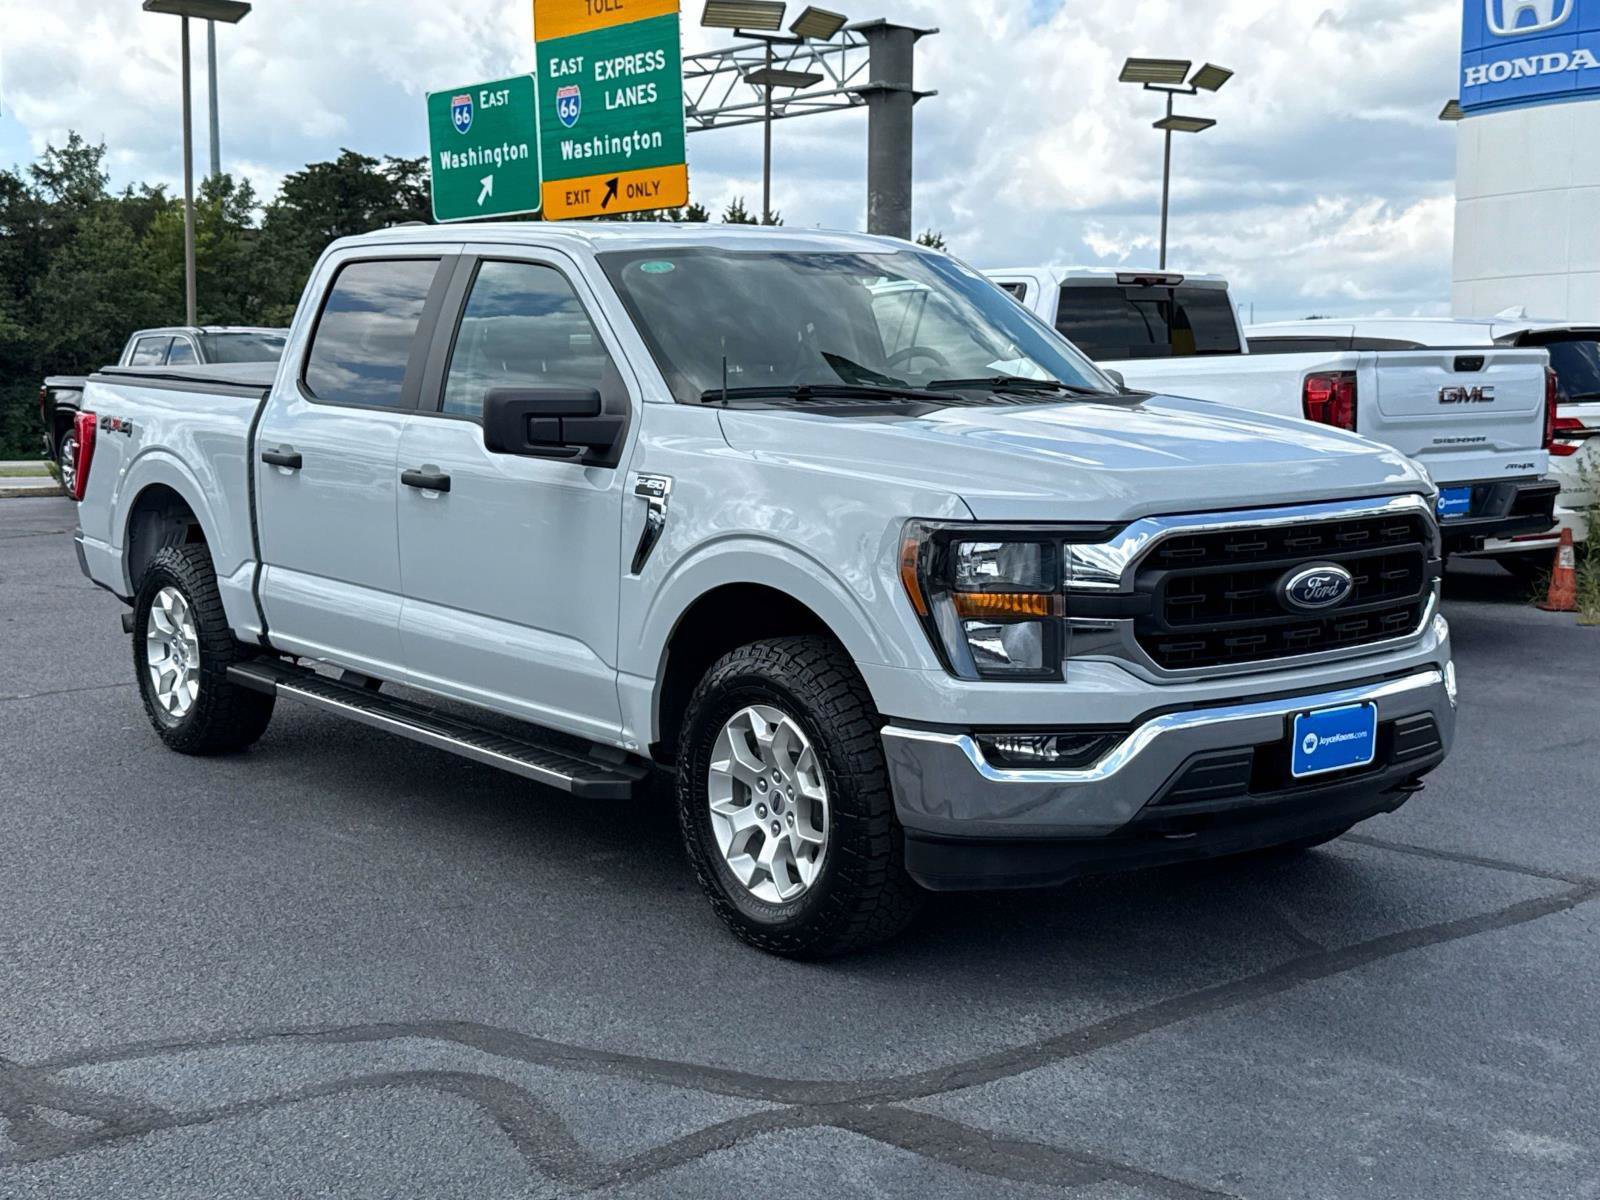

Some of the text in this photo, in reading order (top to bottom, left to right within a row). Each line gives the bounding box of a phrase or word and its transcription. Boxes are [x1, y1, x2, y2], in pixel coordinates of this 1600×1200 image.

[549, 56, 584, 78] EAST
[594, 49, 666, 81] EXPRESS
[1463, 49, 1600, 87] HONDA
[479, 90, 510, 109] EAST
[560, 98, 578, 118] 66
[604, 83, 657, 110] LANES
[454, 106, 471, 125] 66
[440, 142, 528, 170] Washington
[560, 130, 662, 160] Washington
[565, 180, 661, 206] EXIT ONLY
[1438, 386, 1495, 404] GMC
[1304, 576, 1340, 600] Ford
